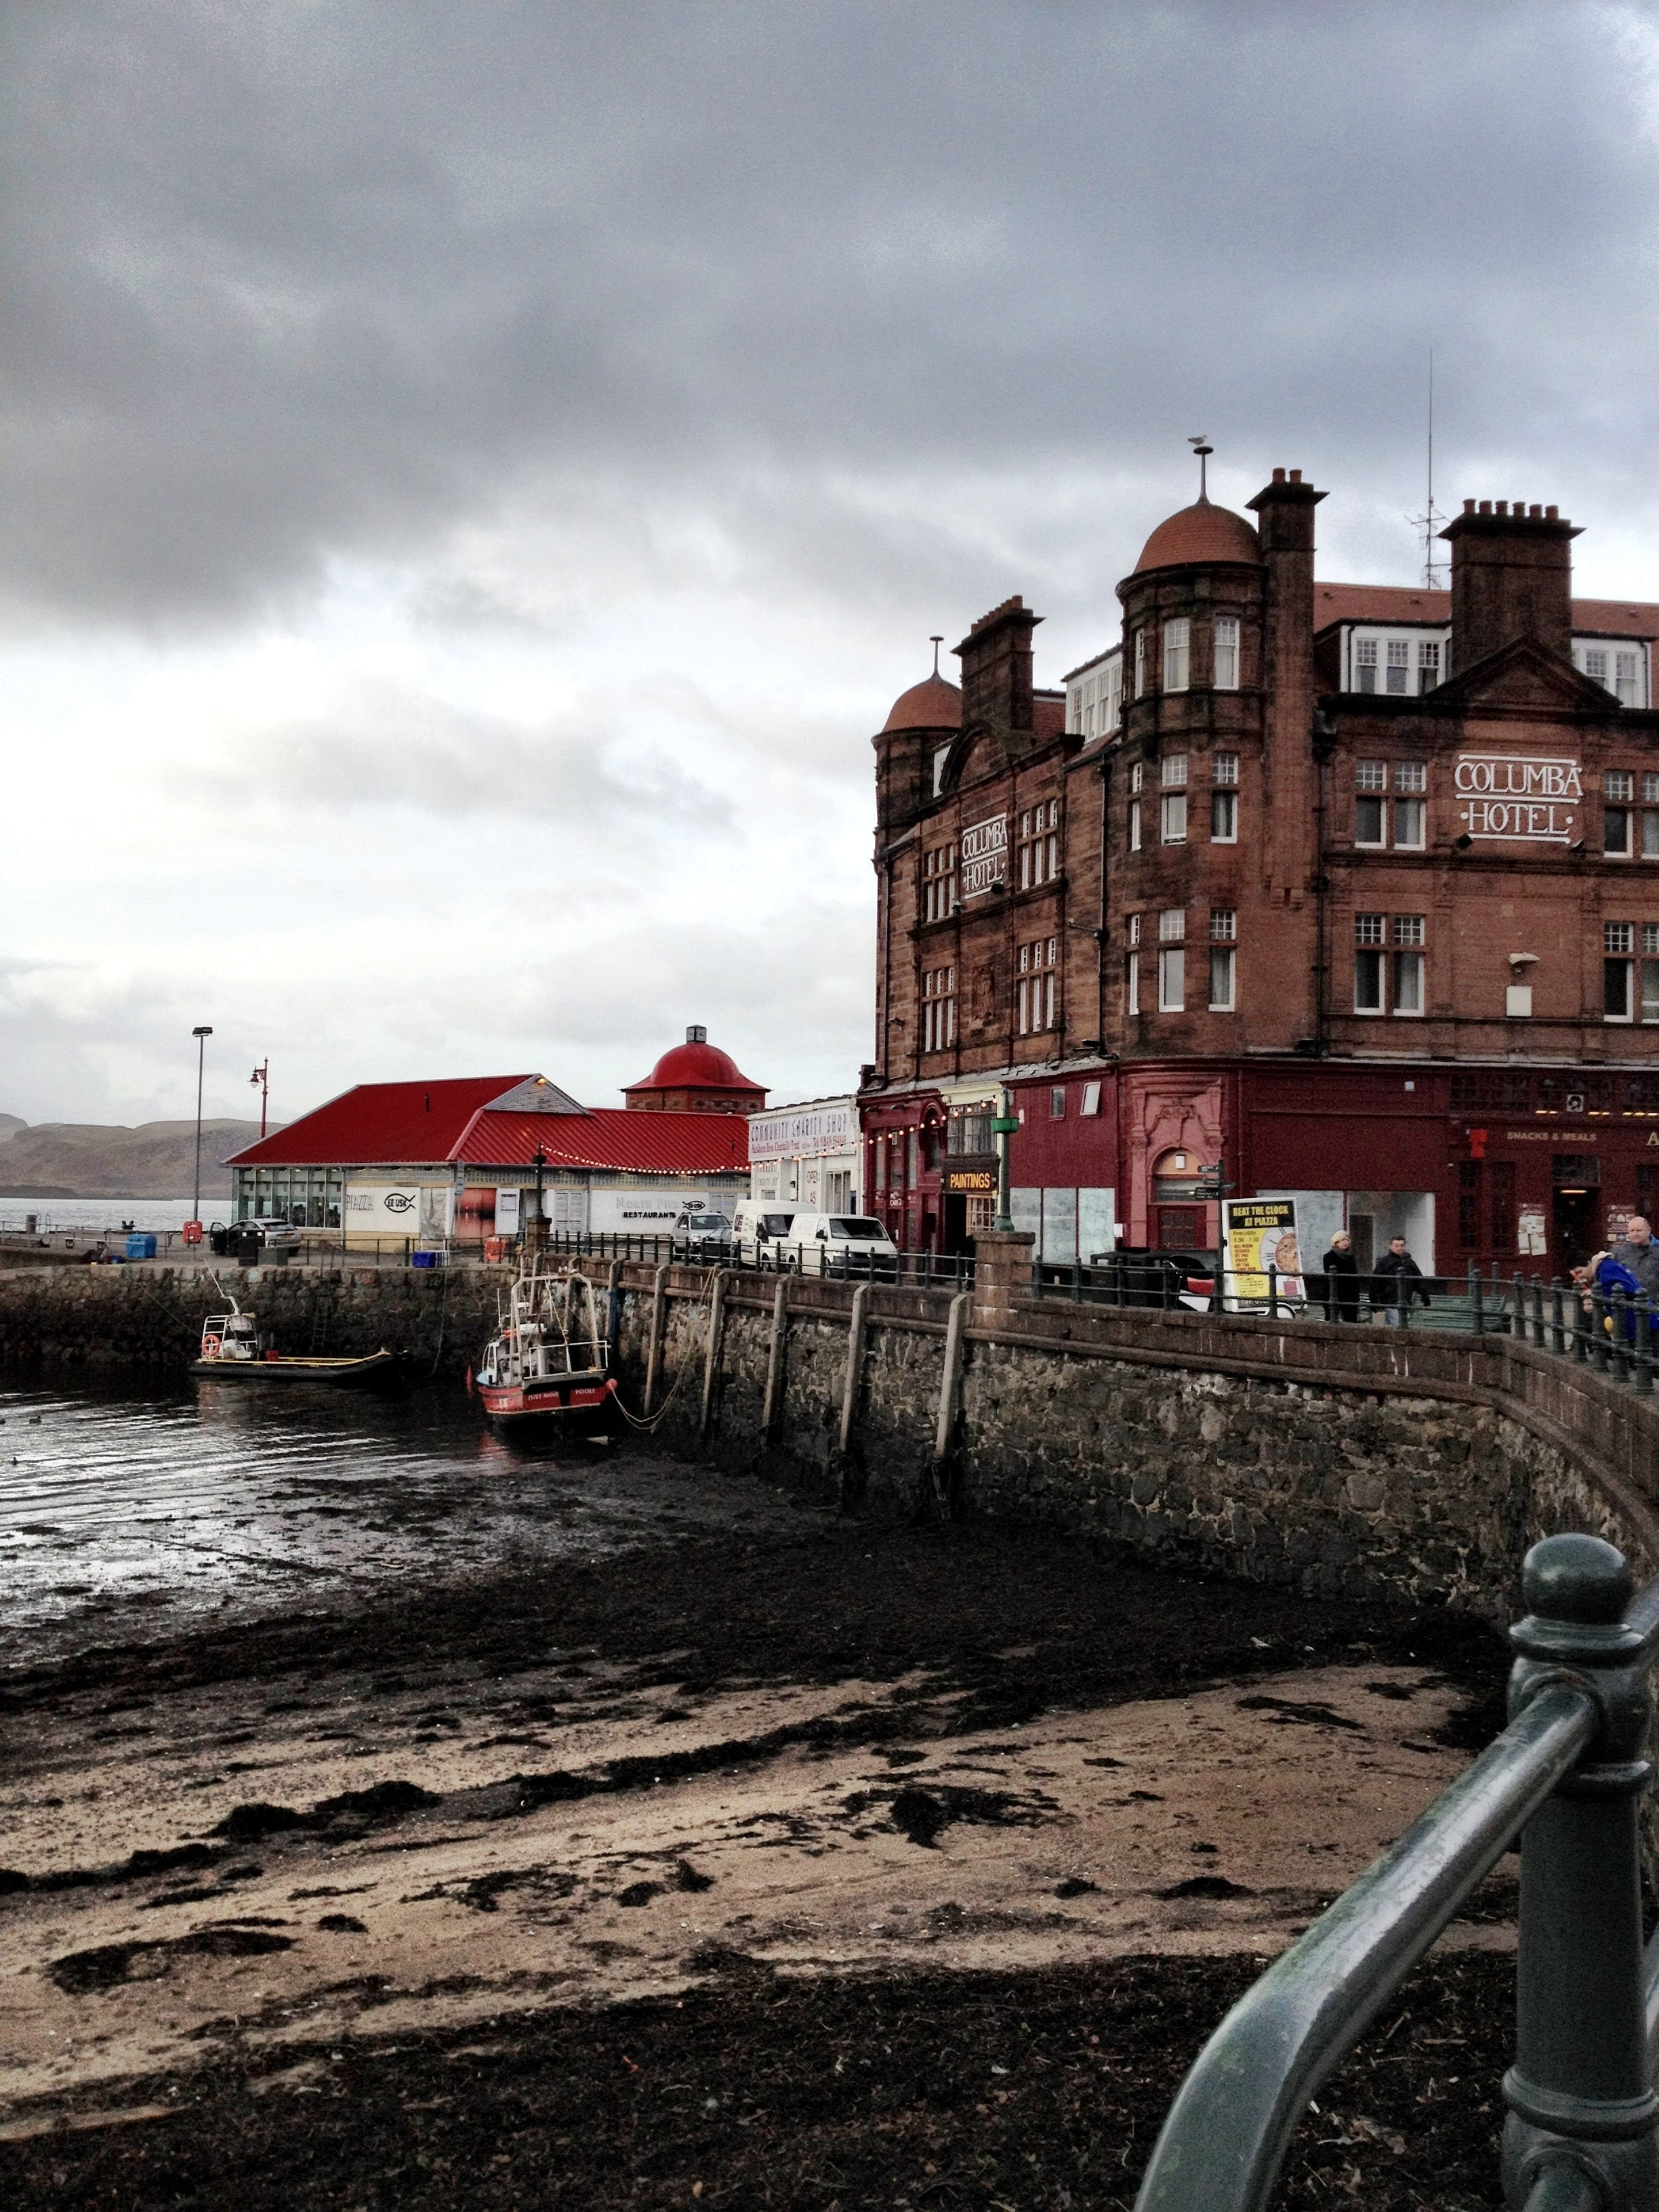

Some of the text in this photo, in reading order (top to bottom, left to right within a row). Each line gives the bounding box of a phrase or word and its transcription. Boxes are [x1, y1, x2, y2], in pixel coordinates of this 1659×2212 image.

[1455, 762, 1584, 796] COLUMBA
[1469, 802, 1570, 835] HOTEL
[962, 819, 1008, 860] COLUMBA
[966, 857, 1003, 891] HOTEL
[752, 1113, 846, 1142] COMMUNITY CHARITY SHOP
[1507, 1132, 1597, 1141] SNACKS & MEALS
[950, 1173, 990, 1188] PAINTINGS
[346, 1194, 374, 1211] PIAZZA
[1233, 1205, 1289, 1216] BEAT THE CLOCK
[1244, 1216, 1279, 1227] AT PIAZZA
